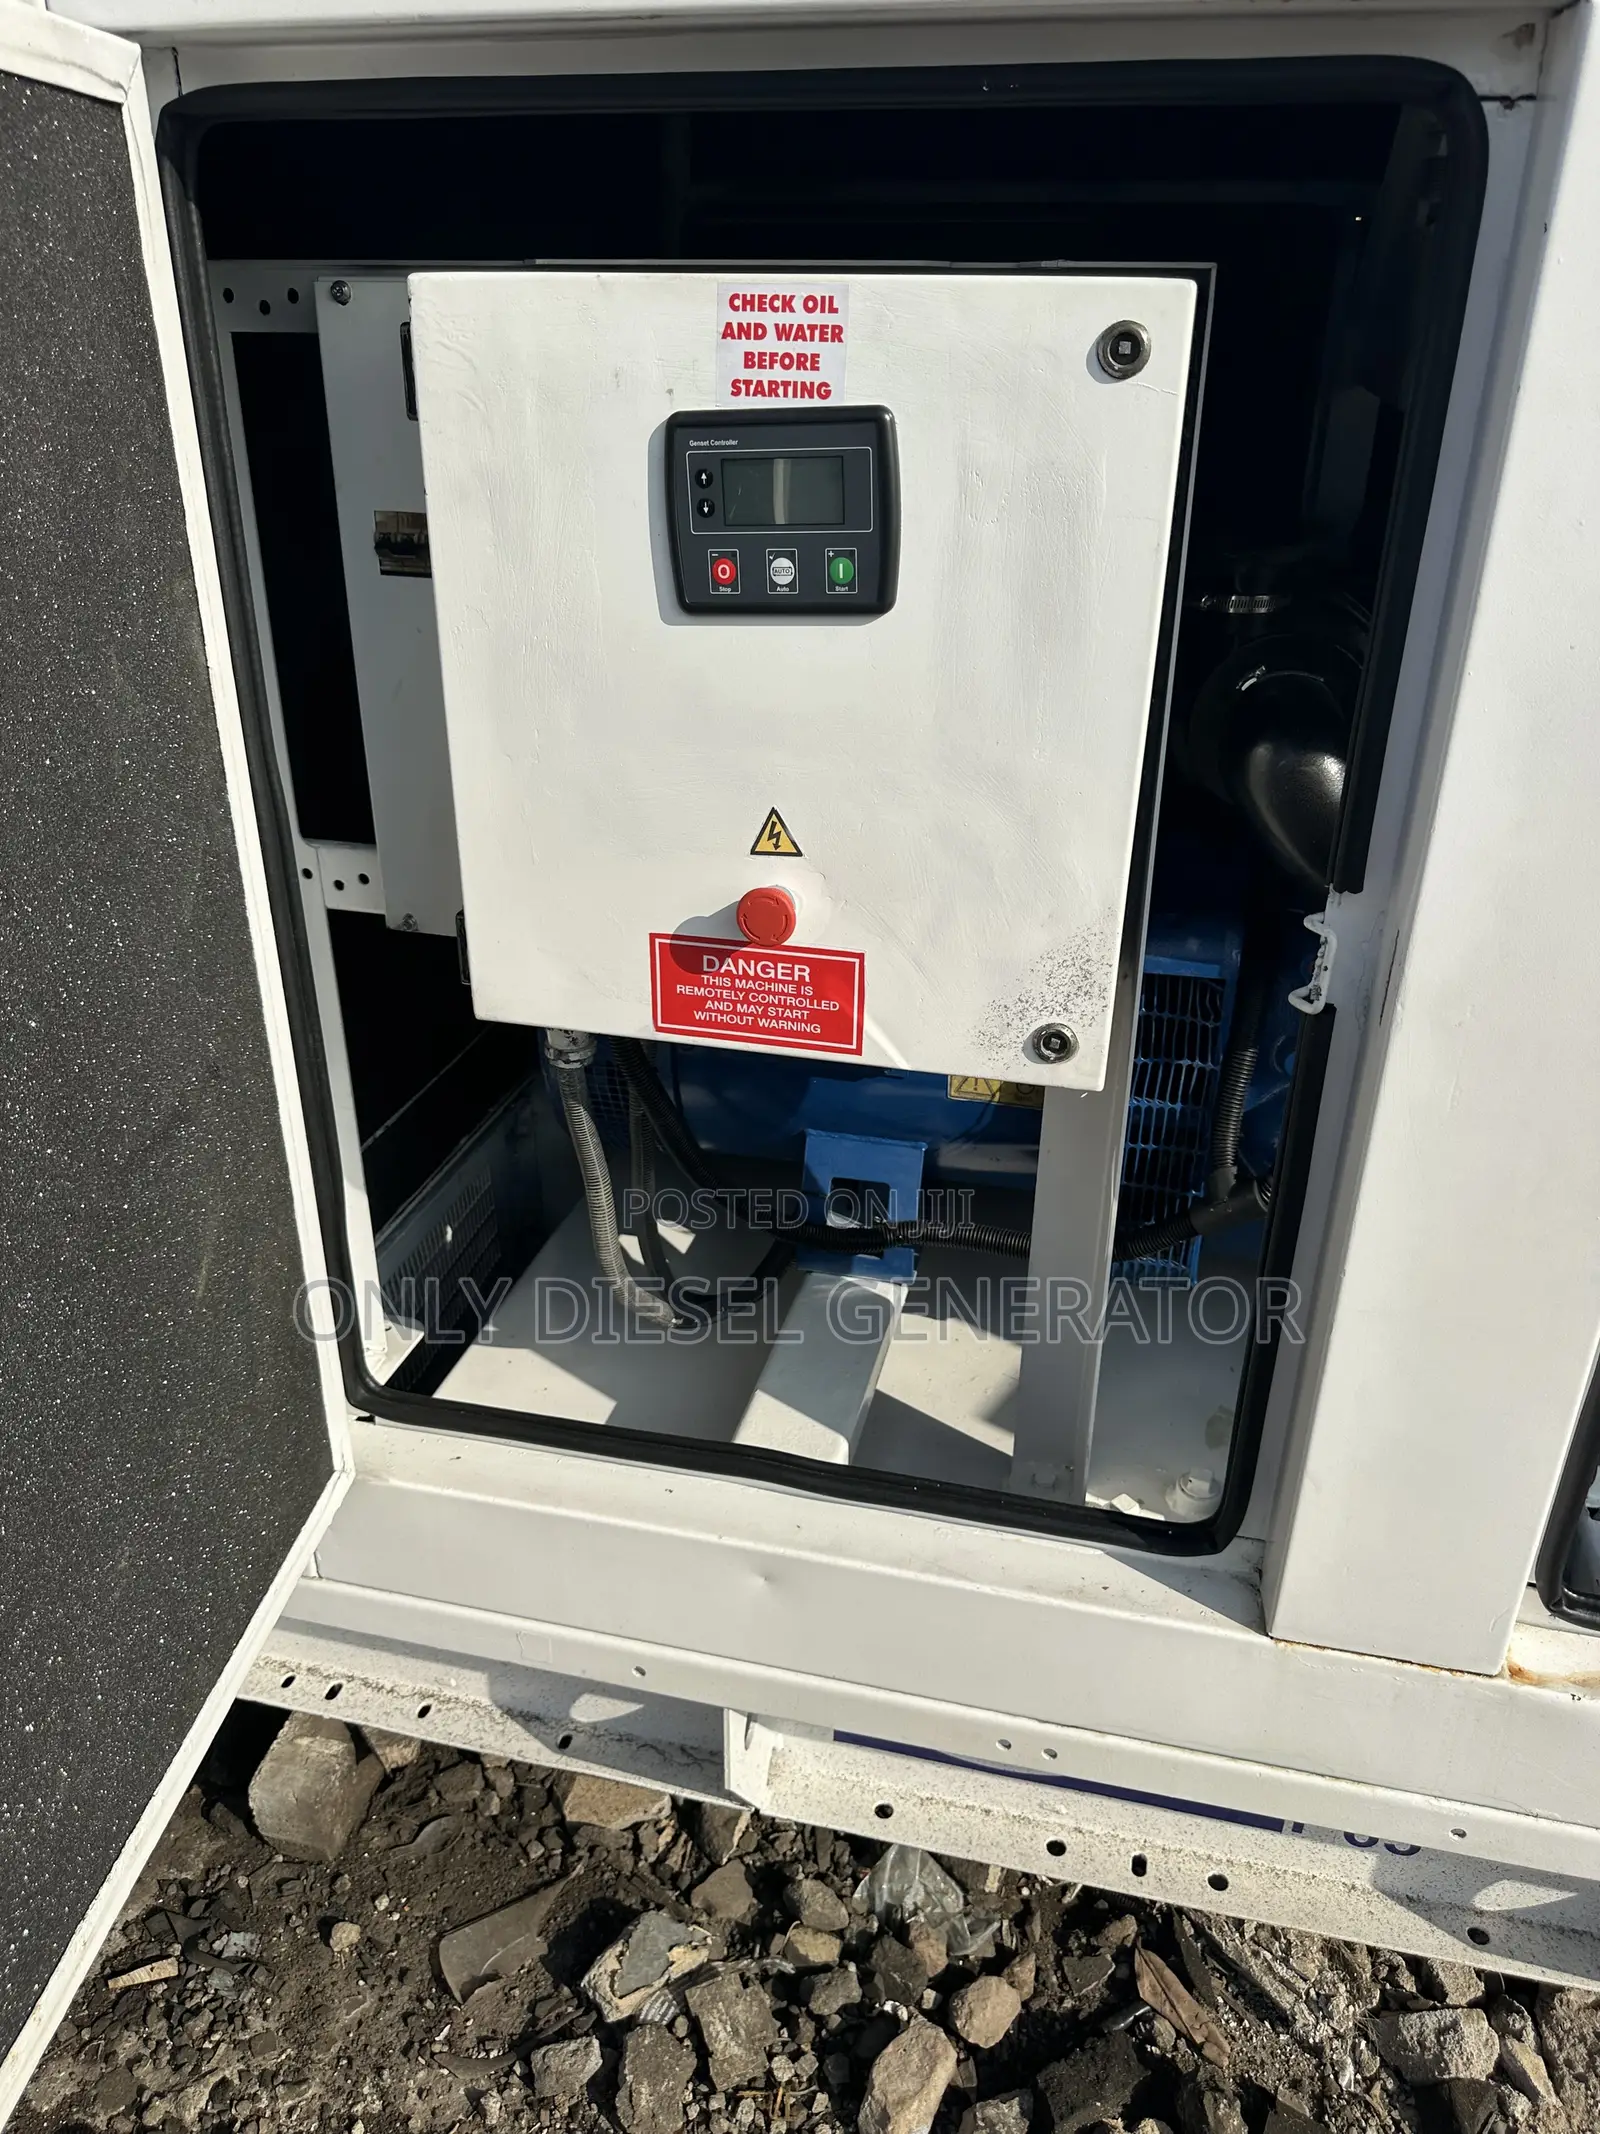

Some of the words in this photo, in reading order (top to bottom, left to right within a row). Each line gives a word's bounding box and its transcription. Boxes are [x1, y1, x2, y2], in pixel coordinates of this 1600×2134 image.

[728, 293, 796, 314] CHECK
[803, 294, 839, 315] OIL
[721, 322, 767, 341] AND
[774, 323, 844, 343] WATER
[743, 351, 820, 372] BEFORE
[730, 379, 832, 400] STARTING
[703, 955, 811, 982] DANGER
[701, 975, 731, 987] THIS
[735, 979, 797, 994] MACHINE
[801, 986, 813, 996] IS
[676, 985, 745, 1001] REMOTELY
[749, 992, 839, 1011] CONTROLLED
[705, 1000, 733, 1012] AND
[737, 1003, 764, 1015] MAY
[767, 1007, 810, 1020] START
[693, 1010, 754, 1026] WITHOUT
[757, 1017, 821, 1034] WARNING
